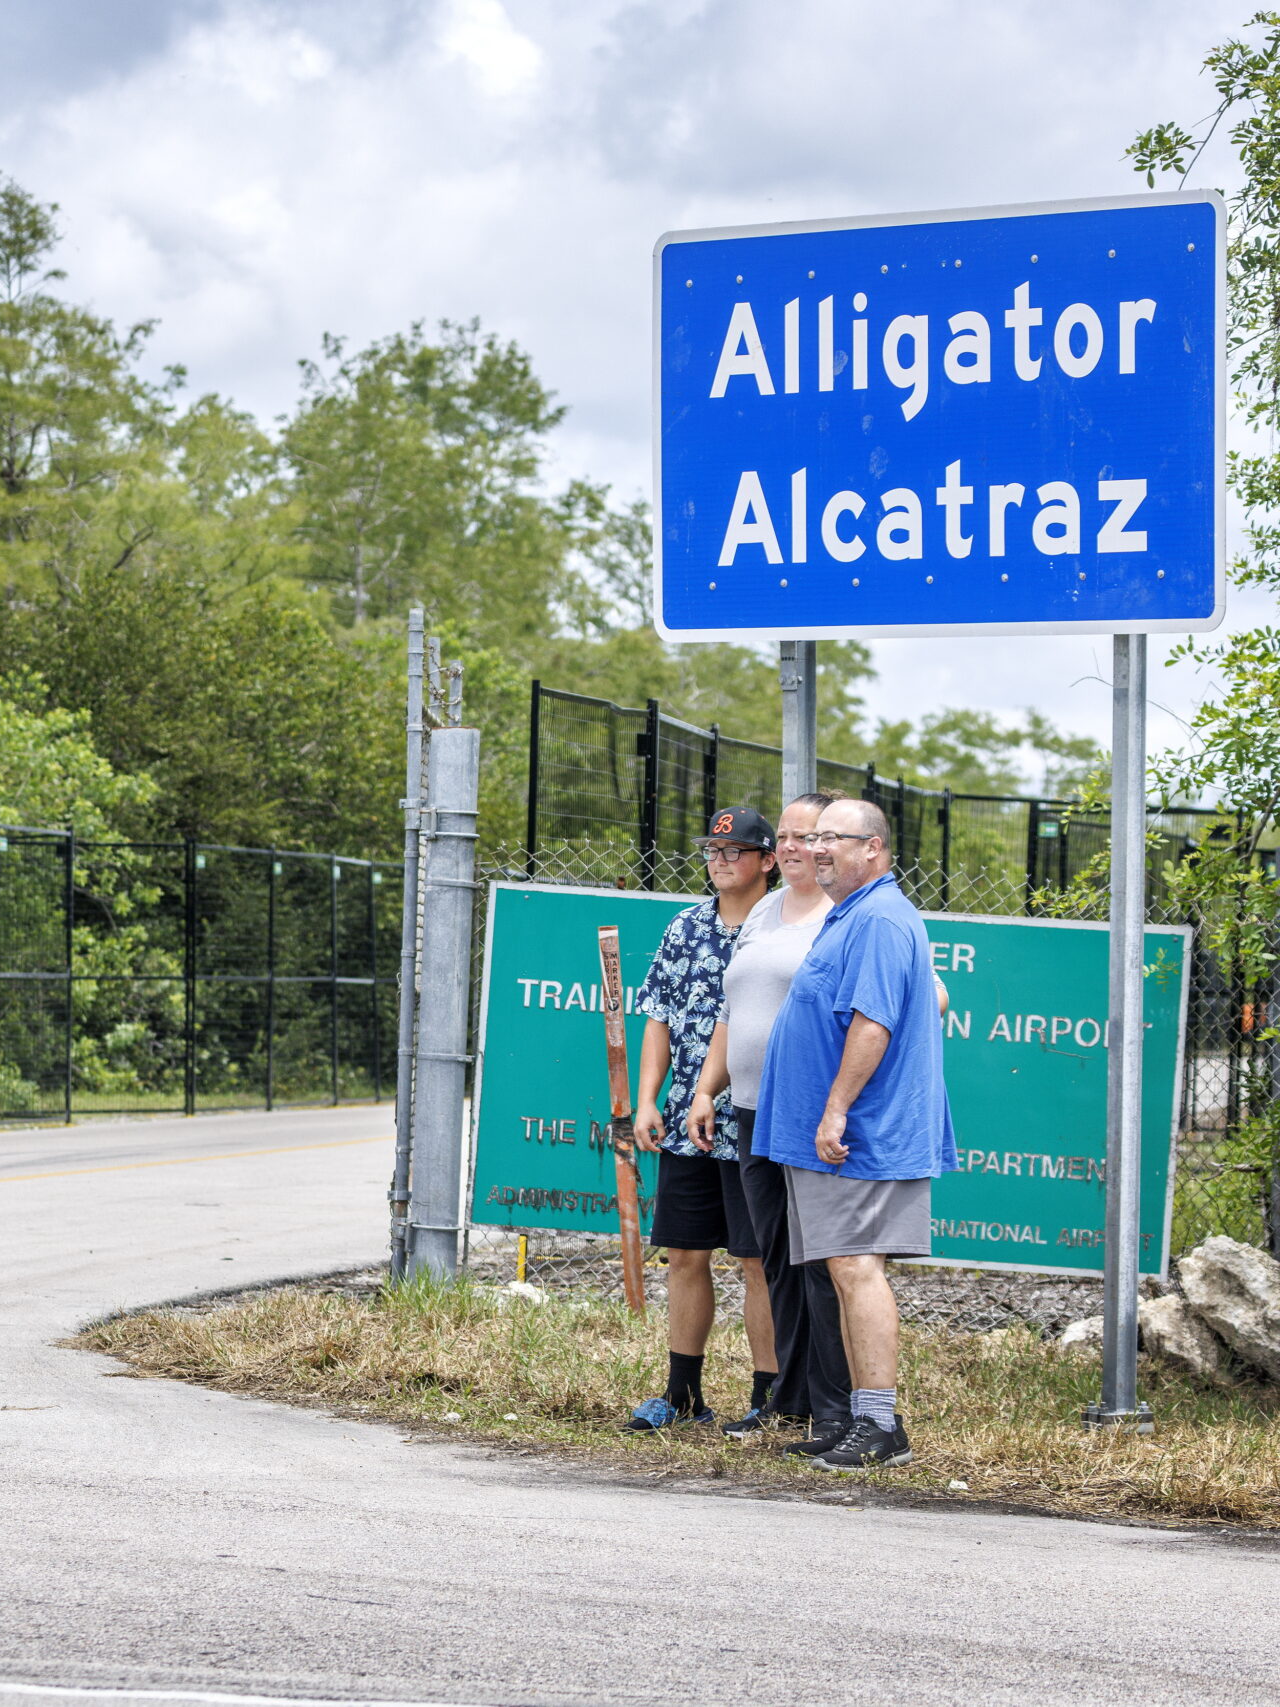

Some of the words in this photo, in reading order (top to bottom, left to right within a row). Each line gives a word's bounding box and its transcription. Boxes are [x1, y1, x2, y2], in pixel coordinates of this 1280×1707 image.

[709, 281, 1157, 423] Alligator
[717, 459, 1148, 567] Alcatraz
[712, 814, 734, 834] B
[610, 952, 619, 997] MARKER
[987, 1013, 1153, 1048] AIRPO
[521, 1116, 577, 1144] THE
[952, 1149, 1107, 1182] EPARTMEN
[929, 1218, 1048, 1245] RNATIONAL
[1056, 1228, 1154, 1251] AIRPT
